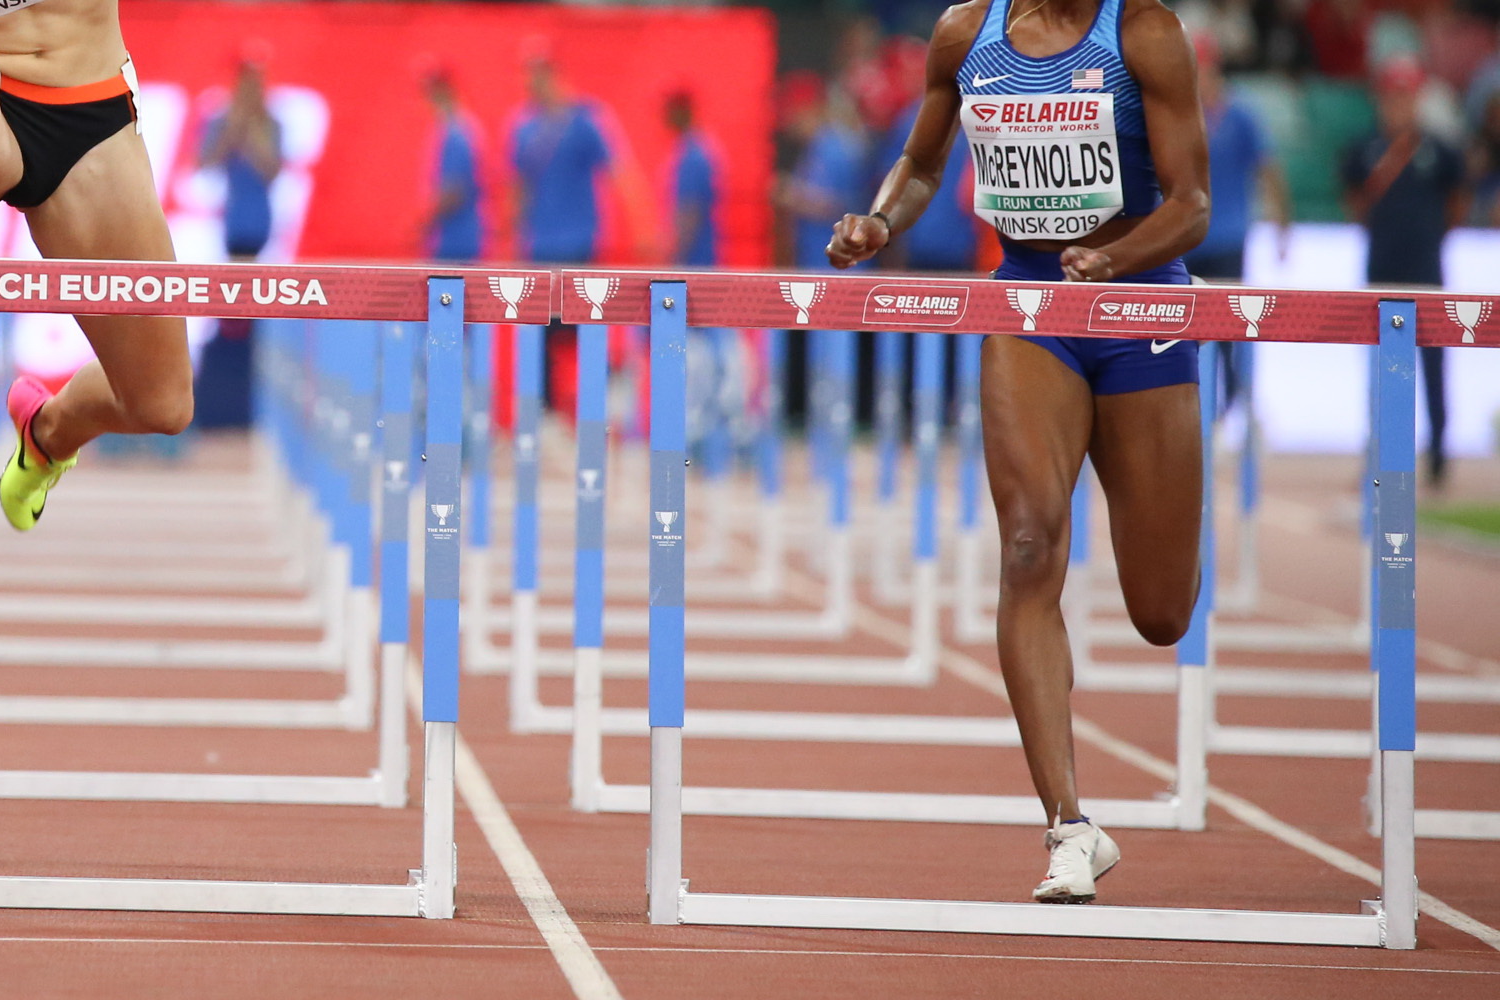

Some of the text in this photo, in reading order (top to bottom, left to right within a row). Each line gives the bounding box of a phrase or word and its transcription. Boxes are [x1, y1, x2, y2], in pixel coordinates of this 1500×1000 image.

[1001, 101, 1099, 123] BELARUS
[975, 123, 1099, 133] MINSK TRACTOR WORKS
[973, 141, 1114, 189] McREYNOLDS
[997, 197, 1001, 208] I
[1003, 197, 1031, 209] RUN
[994, 214, 1100, 234] MINSK 2019
[59, 274, 209, 303] EUROPE
[220, 282, 242, 303] v
[251, 277, 328, 305] USA
[895, 295, 960, 309] BELARUS
[1121, 303, 1186, 317] BELARUS
